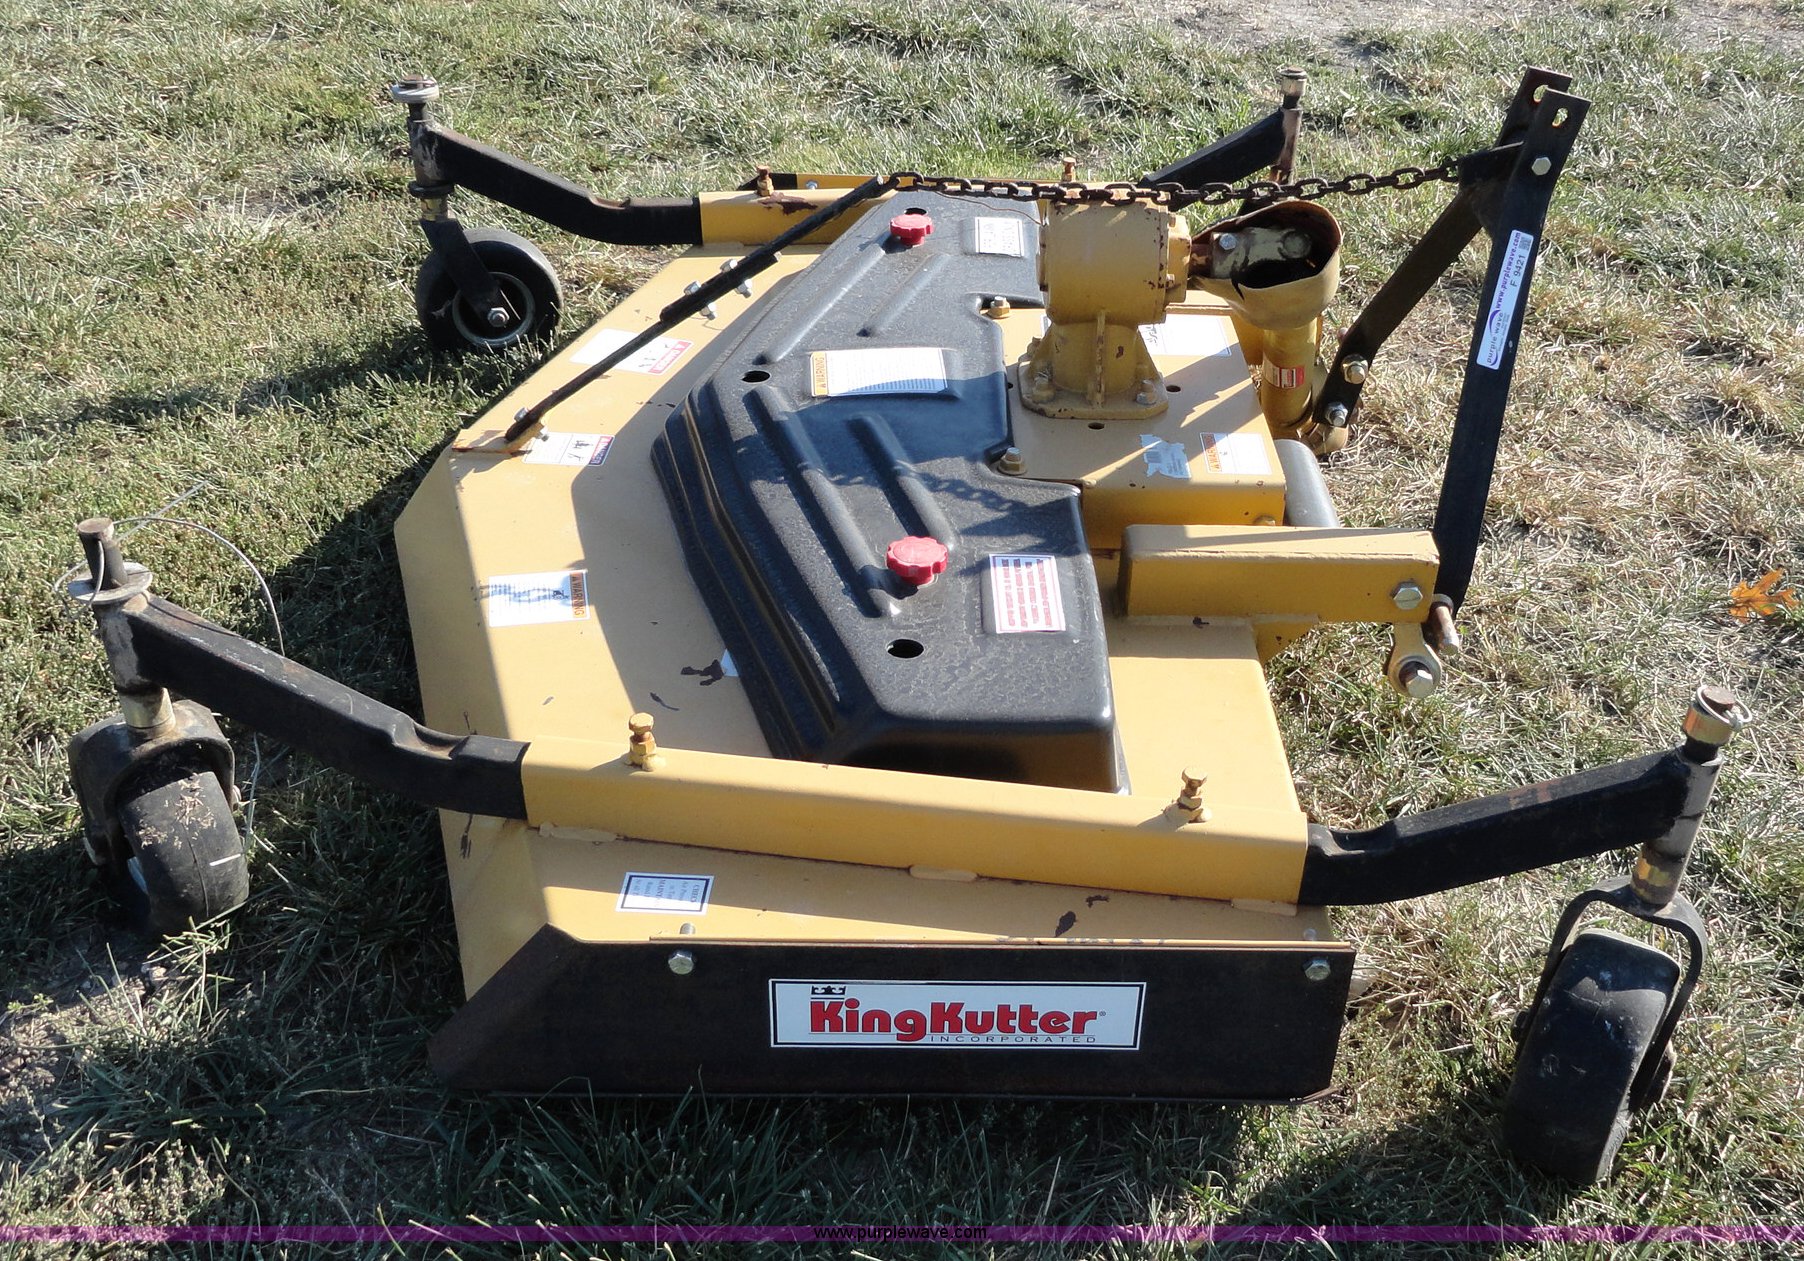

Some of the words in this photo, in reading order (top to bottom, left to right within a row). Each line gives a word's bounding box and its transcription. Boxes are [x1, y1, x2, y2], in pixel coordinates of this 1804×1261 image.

[1496, 232, 1521, 309] www.purplewave.com
[1510, 280, 1518, 288] F
[1514, 254, 1526, 277] 9421
[1486, 335, 1498, 364] purple
[1494, 312, 1504, 335] wave
[572, 581, 584, 616] WARNING
[930, 1035, 1097, 1044] INCORPORATED
